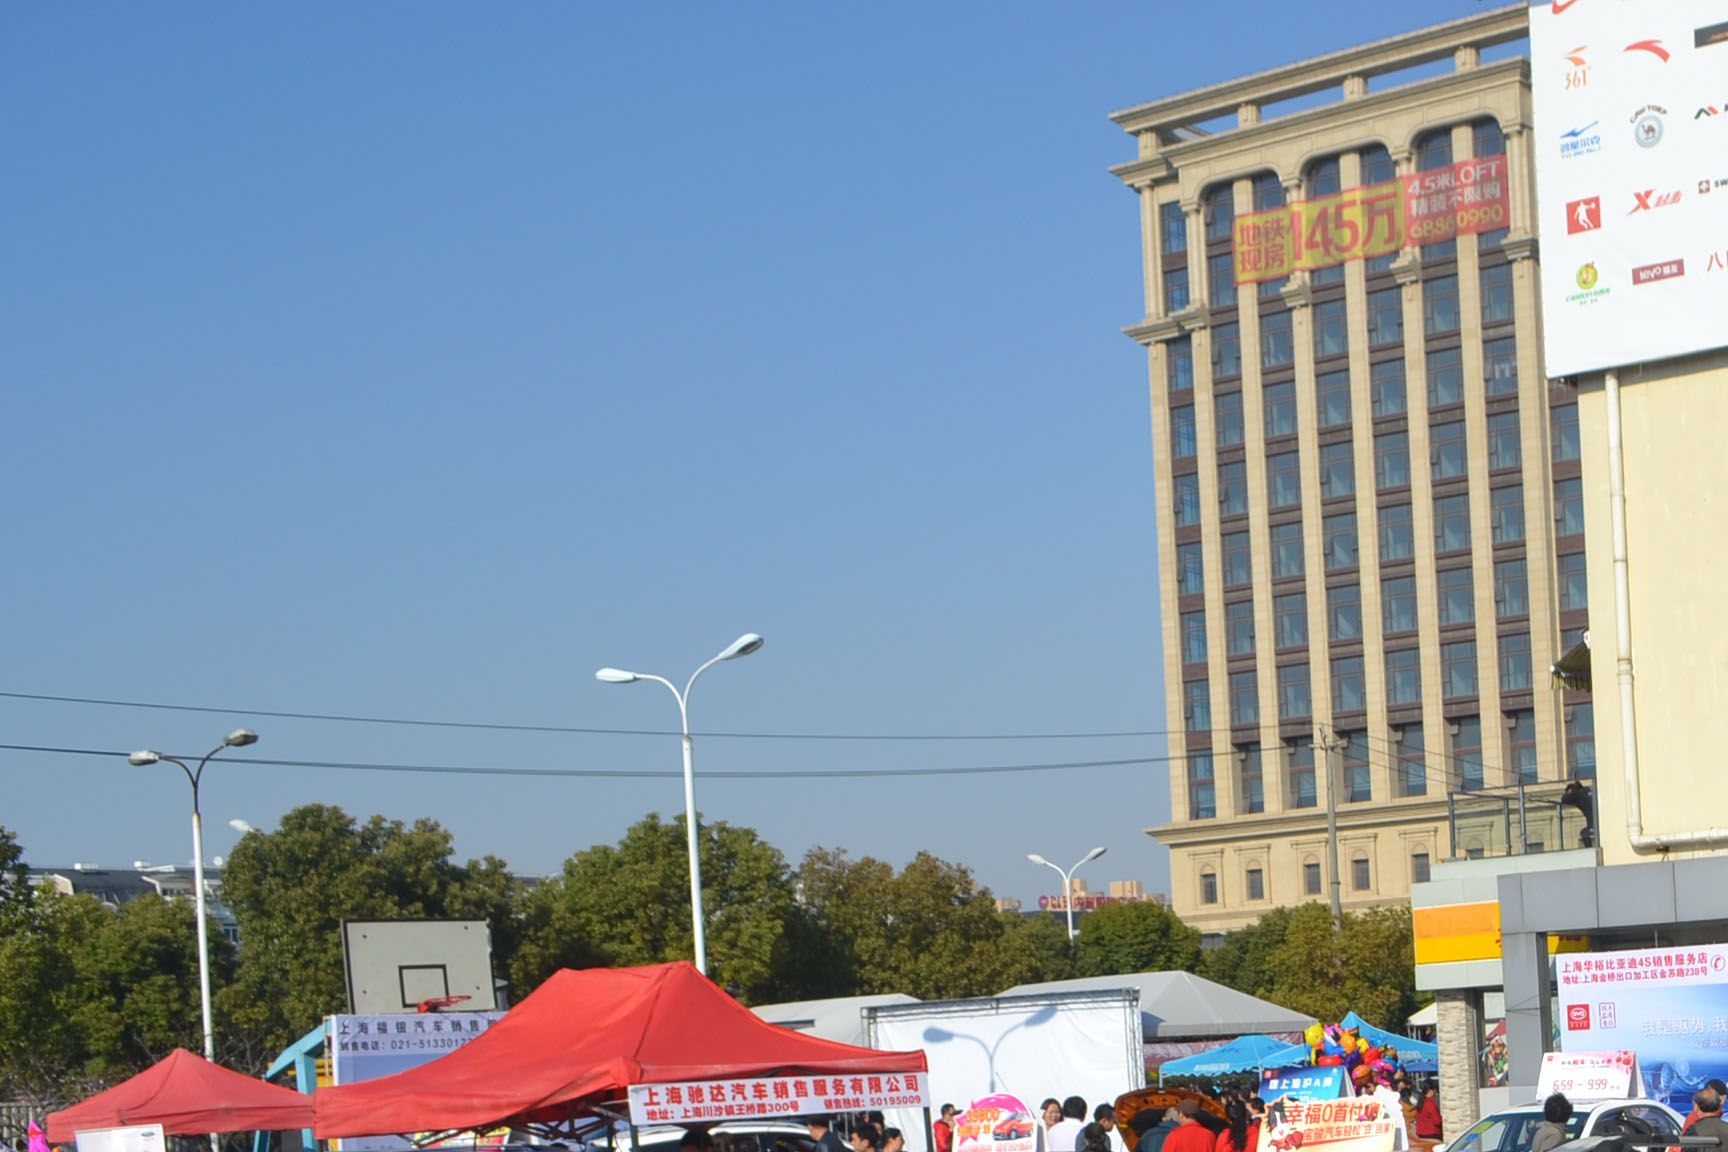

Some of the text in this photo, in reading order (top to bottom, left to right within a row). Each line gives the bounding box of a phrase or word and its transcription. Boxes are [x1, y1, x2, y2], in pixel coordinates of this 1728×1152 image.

[1238, 216, 1286, 248] 地铁
[1291, 191, 1399, 261] 145万
[1239, 243, 1286, 273] 现房
[643, 1074, 921, 1108] 上海驰达汽车销售服务有限公司
